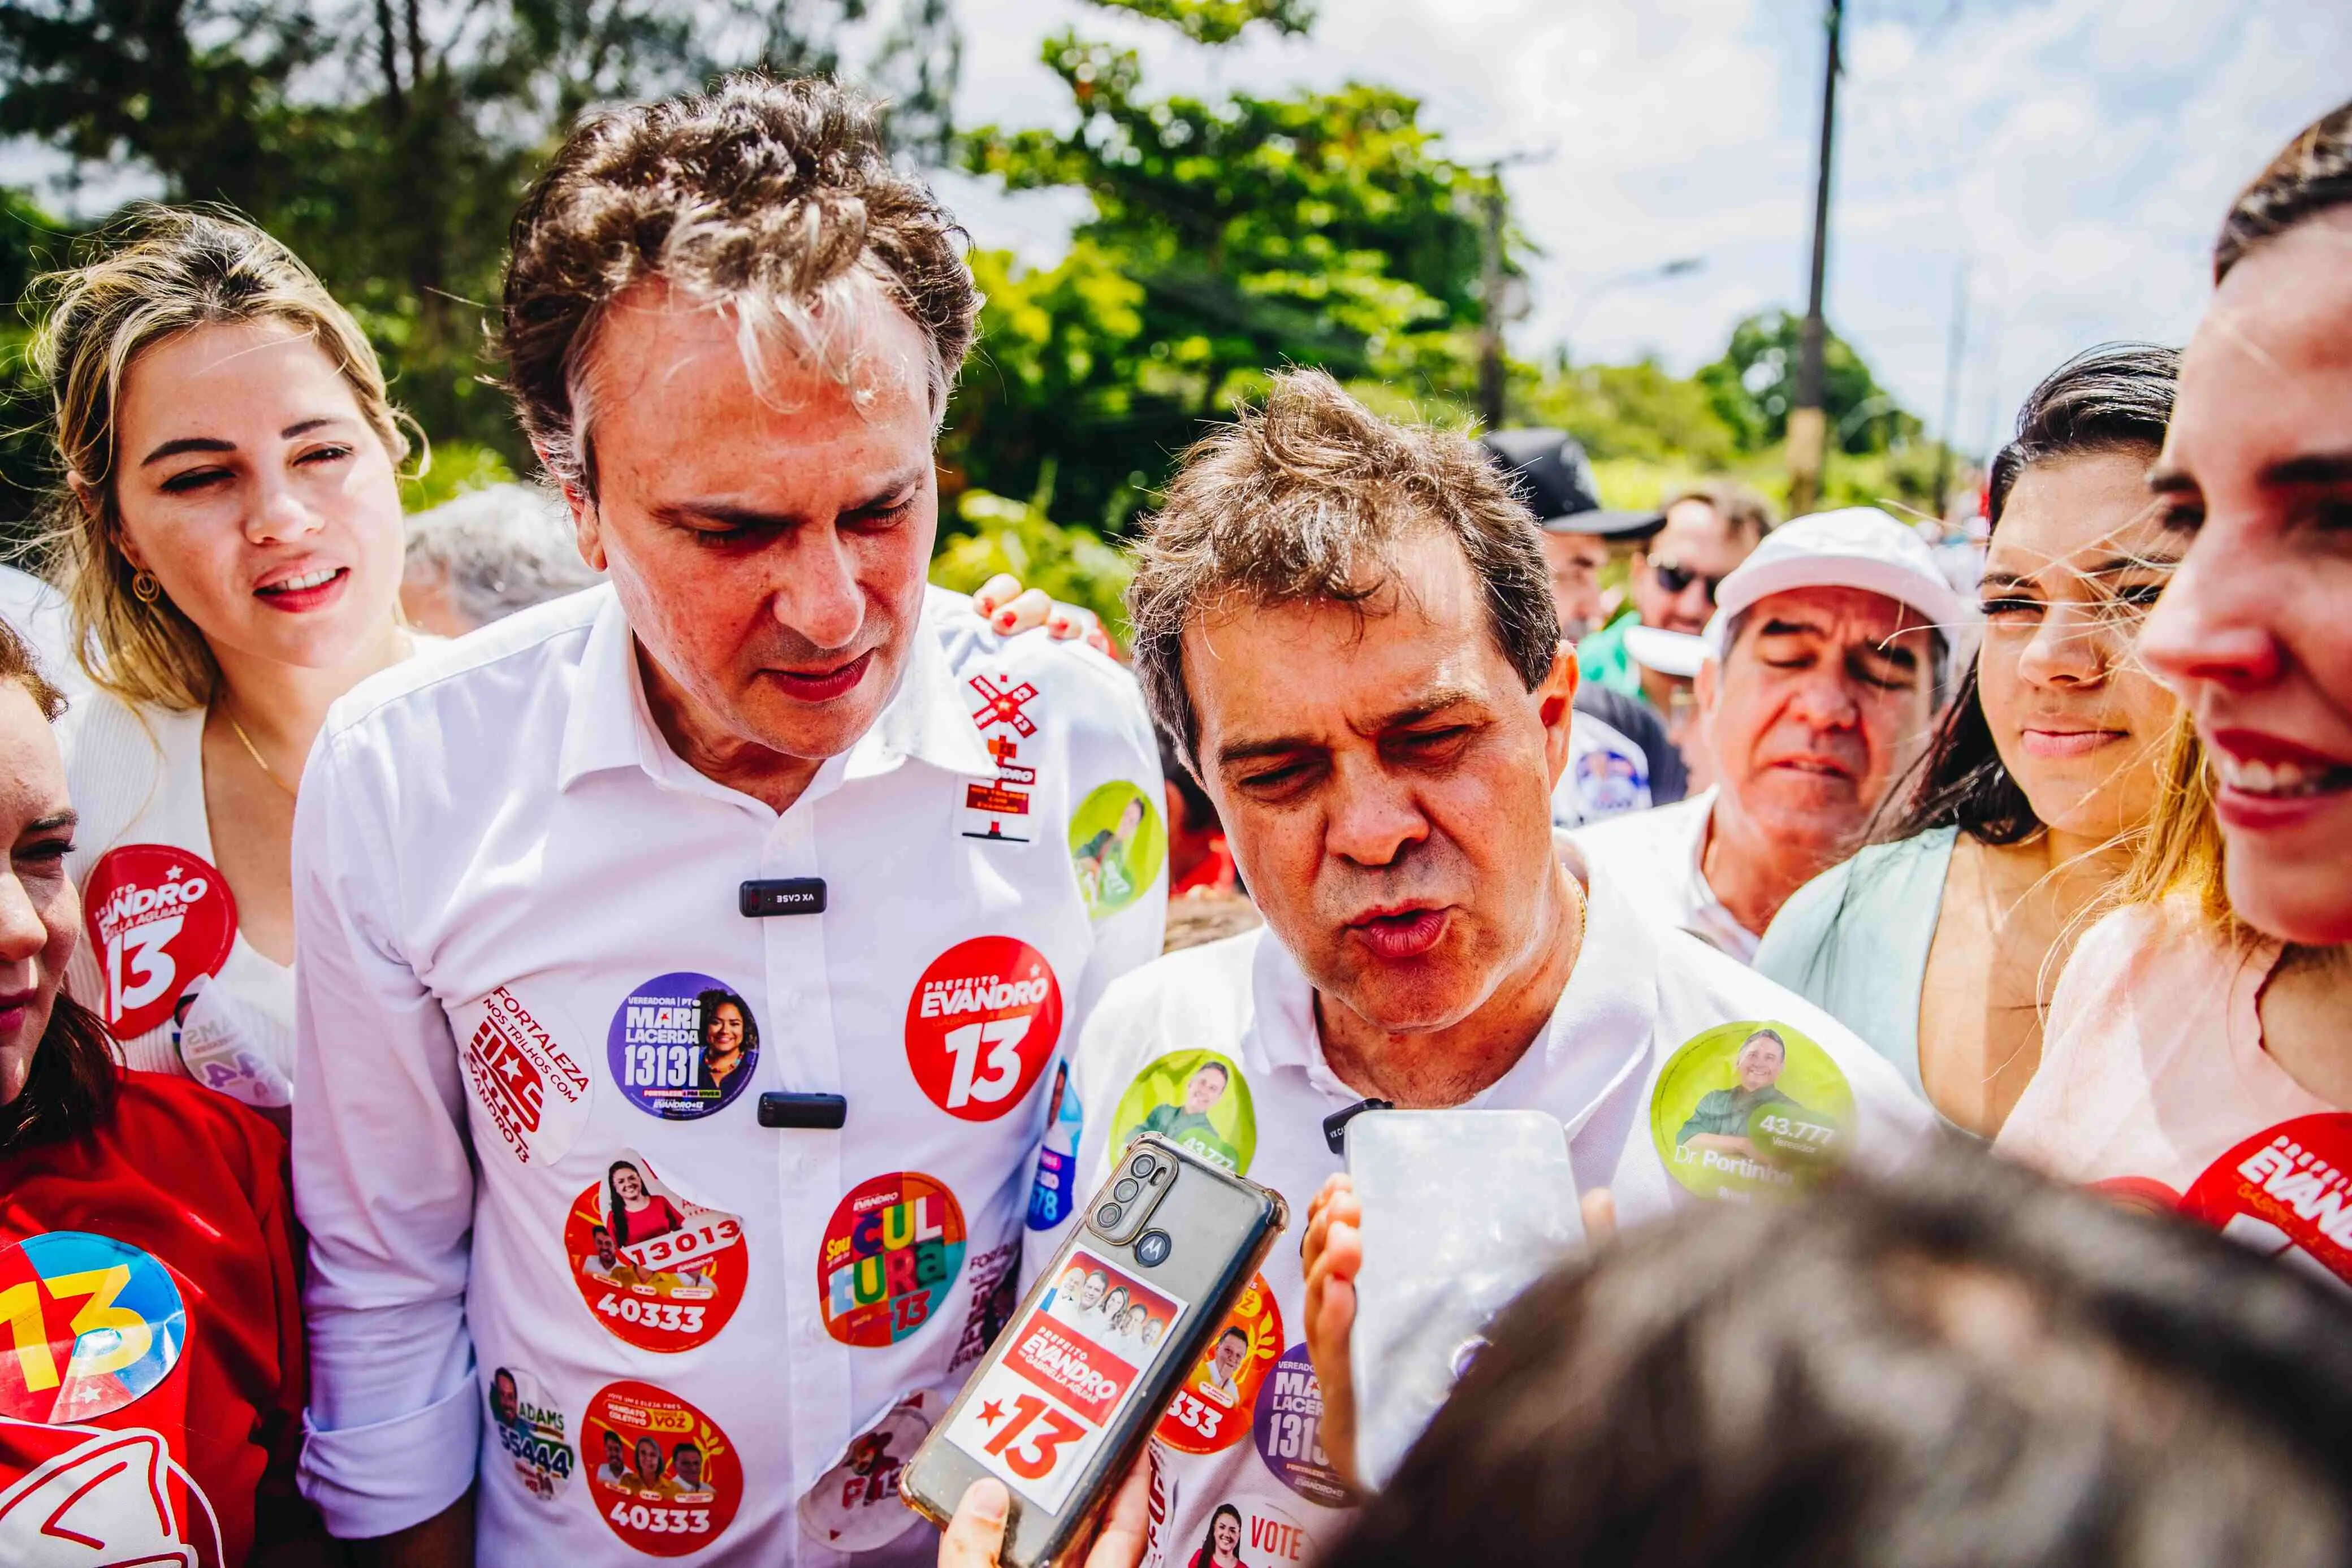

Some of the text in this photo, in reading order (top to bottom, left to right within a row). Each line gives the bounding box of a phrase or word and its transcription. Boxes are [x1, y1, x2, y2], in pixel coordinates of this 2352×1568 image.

[98, 877, 208, 945] ENDRO
[106, 915, 185, 1024] 13
[924, 974, 999, 991] PREFEITO
[628, 997, 676, 1006] VEREADORA
[920, 977, 1048, 1018] EVANDRO
[483, 998, 578, 1103] NOS TRILHOS COM
[492, 986, 589, 1092] FORTALEZA
[625, 1029, 699, 1044] LACERDA
[625, 1045, 699, 1086] 13131
[944, 1015, 1032, 1108] 13
[464, 1051, 529, 1163] EVANDRO 13
[1759, 1115, 1835, 1145] 43.777
[2237, 1145, 2352, 1251] EVAN
[631, 1221, 740, 1266] 13013
[0, 1264, 152, 1392] 13
[597, 1293, 706, 1333] 40333
[894, 1289, 931, 1331] 13
[1037, 1326, 1087, 1361] PREFEITO
[1022, 1333, 1117, 1399] EVANDRO
[1026, 1354, 1099, 1405] GABRIELLA AGUIAR
[1275, 1372, 1321, 1399] MA
[1278, 1361, 1315, 1372] VEREADO
[519, 1402, 564, 1430] ADAMS
[655, 1416, 686, 1428] VOZ
[1167, 1391, 1223, 1439] 333
[1273, 1396, 1324, 1415] LACER
[499, 1424, 570, 1479] 55444
[983, 1393, 1088, 1480] 13
[1268, 1412, 1329, 1466] 1313
[1294, 1478, 1333, 1493] EVANDRO
[610, 1501, 710, 1533] 40333
[1252, 1515, 1304, 1561] VOTE
